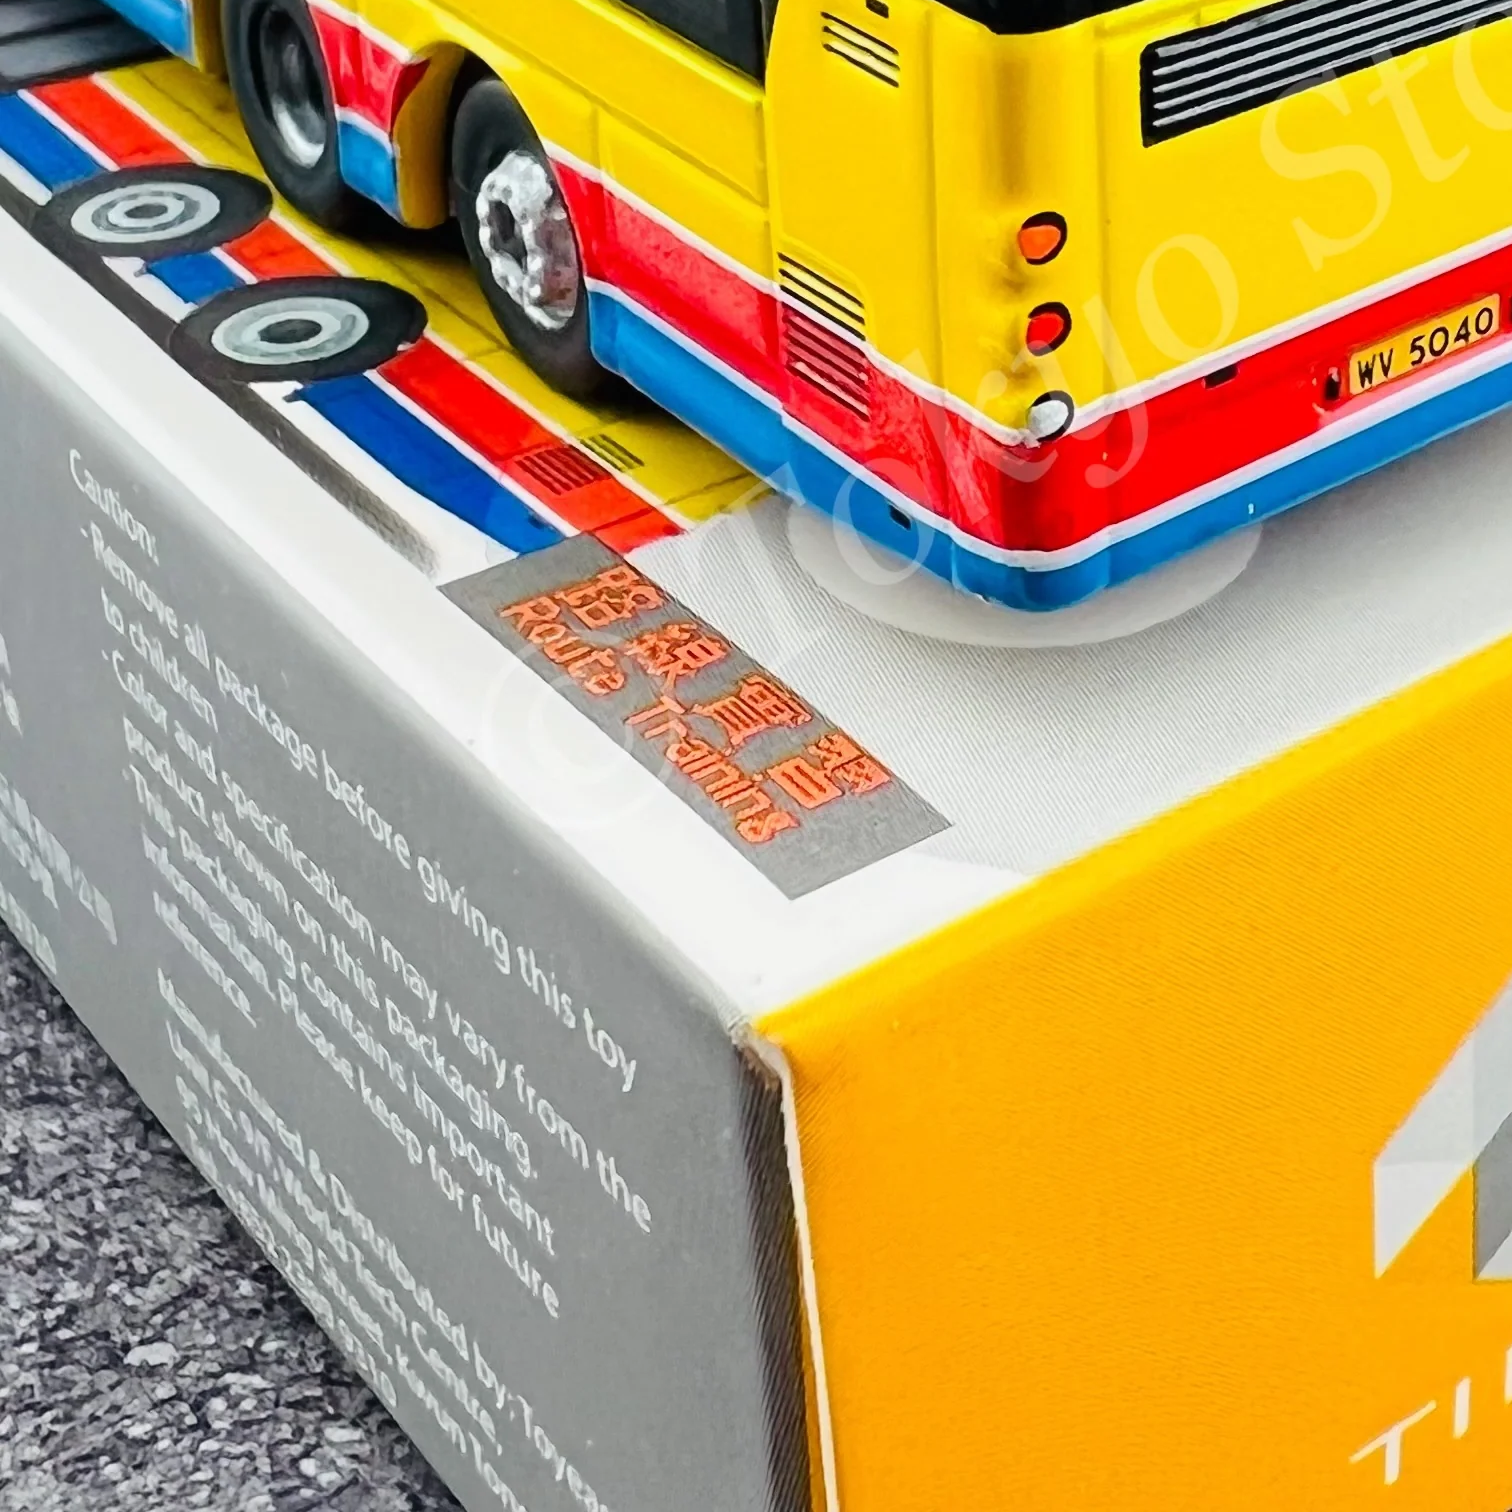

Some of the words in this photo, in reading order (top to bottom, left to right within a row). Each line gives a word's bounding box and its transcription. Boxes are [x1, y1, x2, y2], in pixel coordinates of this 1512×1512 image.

[1357, 346, 1394, 389] WV
[1409, 306, 1494, 368] 5040
[101, 586, 125, 635] to
[129, 621, 219, 733] children
[500, 595, 627, 696] Route
[123, 714, 210, 828] product
[212, 811, 291, 918] shown
[293, 898, 328, 955] on
[331, 933, 380, 1009] this
[385, 996, 539, 1179] packaging.
[174, 719, 218, 785] and
[222, 770, 376, 956] specification
[381, 935, 438, 1020] may
[445, 1000, 507, 1090] vary
[513, 1064, 590, 1169] from
[596, 1148, 652, 1233] the
[179, 826, 297, 978] packaging
[300, 960, 407, 1093] contains
[184, 622, 210, 671] all
[215, 656, 318, 779] package
[321, 748, 411, 870] before
[418, 856, 511, 975] giving
[517, 946, 577, 1029] this
[583, 1007, 637, 1093] toy
[277, 978, 356, 1092] Please
[358, 1065, 422, 1165] keep
[428, 1144, 464, 1212] for
[472, 1193, 560, 1319] future
[517, 1394, 609, 1512] Toyea
